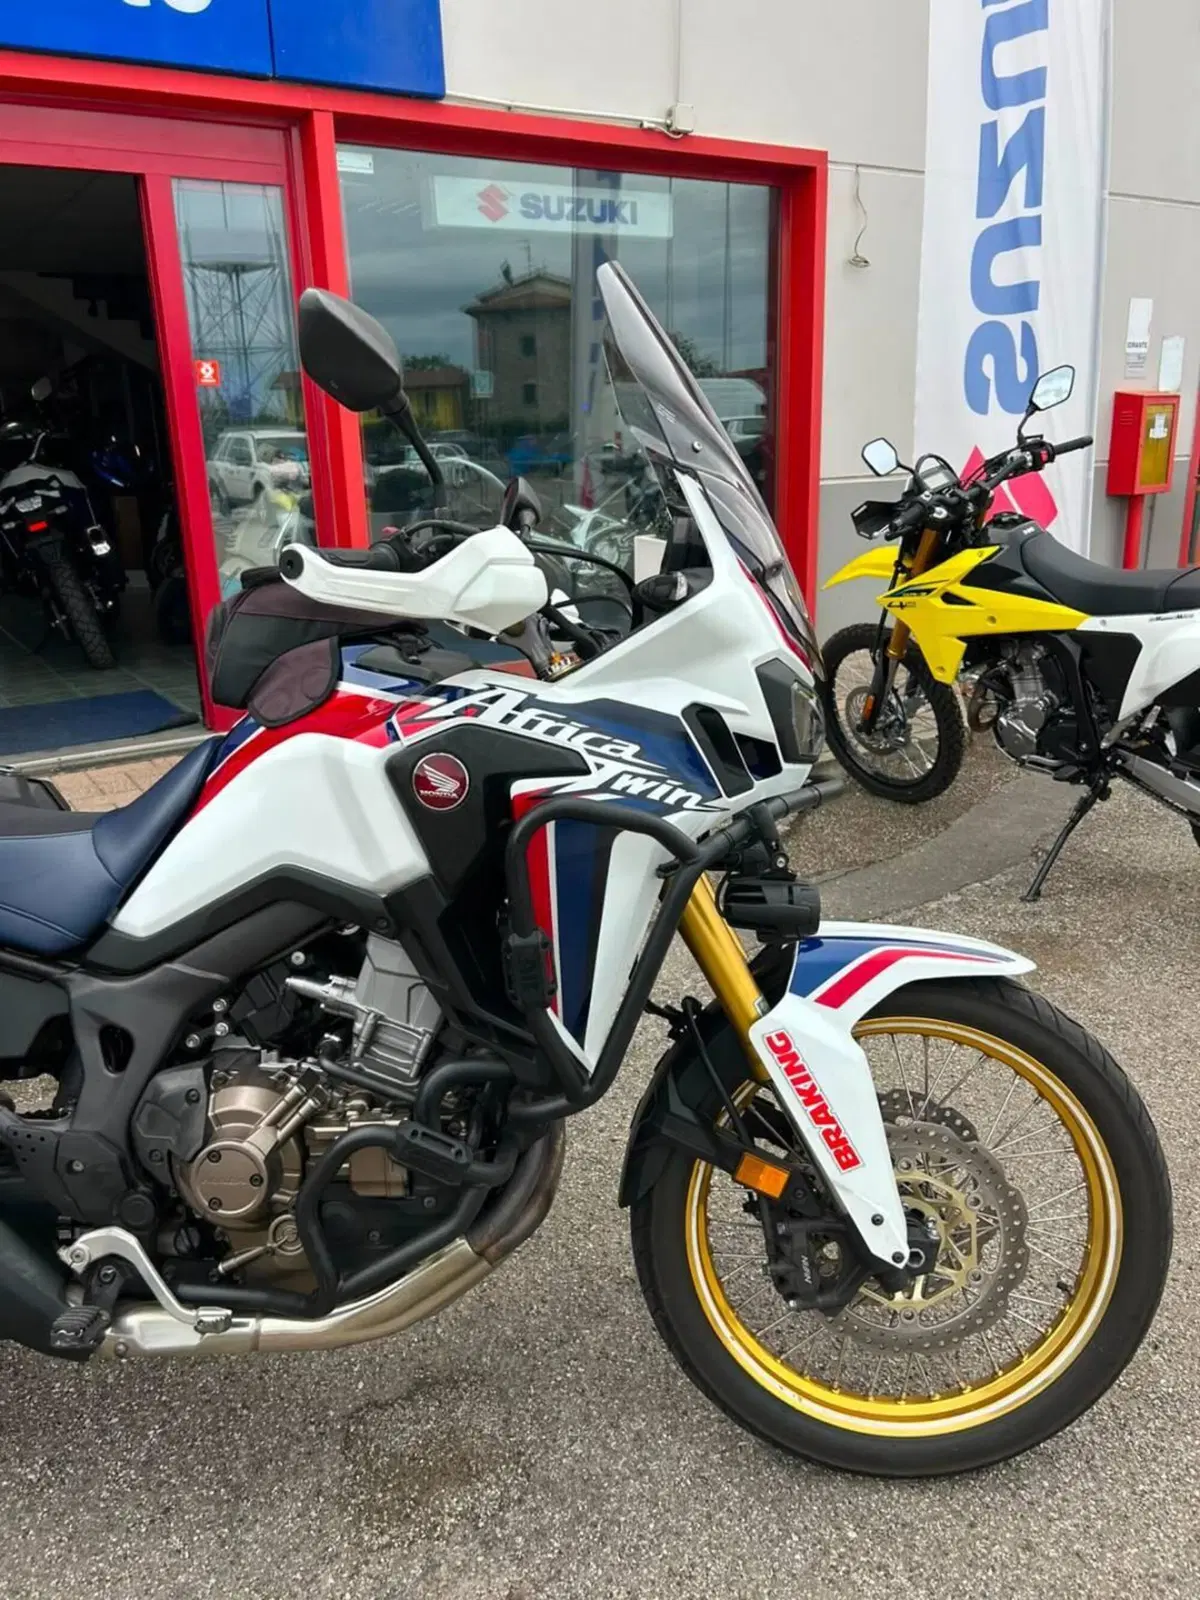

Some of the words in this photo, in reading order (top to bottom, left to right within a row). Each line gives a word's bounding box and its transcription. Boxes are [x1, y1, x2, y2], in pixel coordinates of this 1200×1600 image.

[519, 191, 638, 225] SUZUKI
[414, 684, 667, 770] Africa
[419, 789, 459, 799] HONDA
[553, 752, 730, 813] Twin
[765, 1031, 861, 1171] BRAKING
